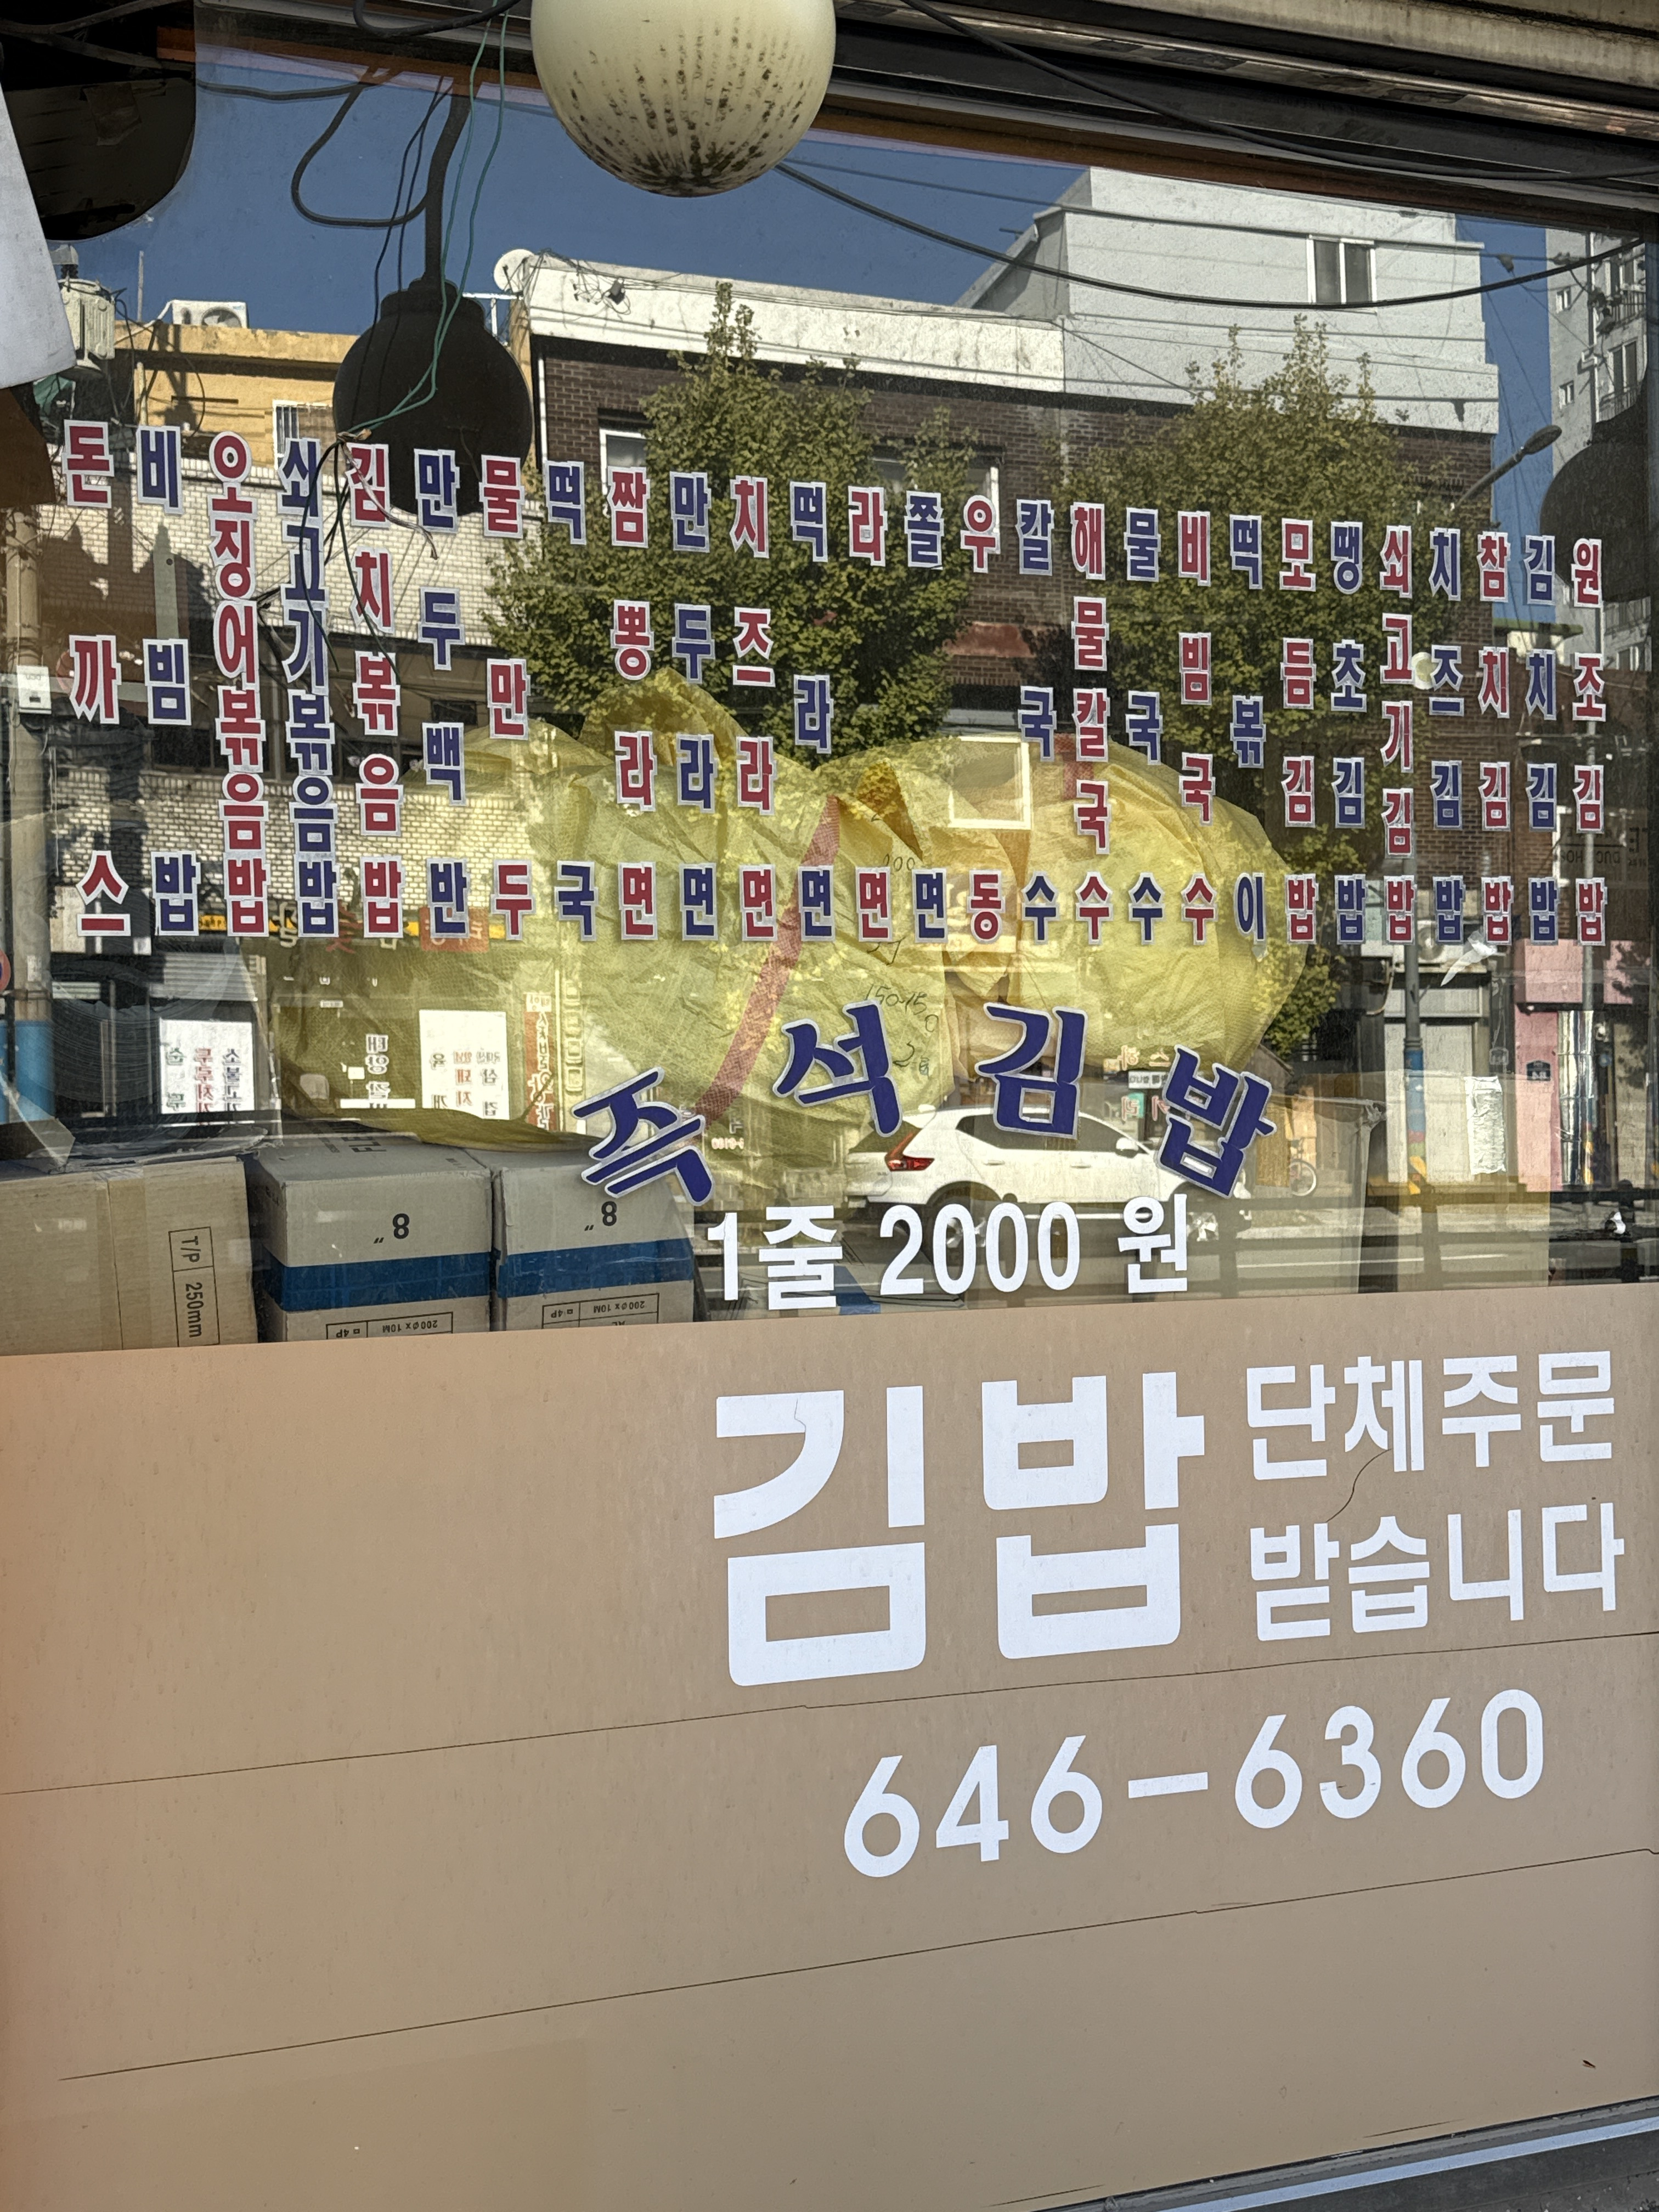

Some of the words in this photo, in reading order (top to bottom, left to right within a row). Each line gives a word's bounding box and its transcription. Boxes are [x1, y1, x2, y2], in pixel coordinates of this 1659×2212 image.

[62, 419, 131, 937] 돈까스
[136, 425, 200, 937] 비빔밥
[209, 431, 269, 938] 오징어볶음밥
[277, 437, 340, 938] 쇠고기볶음밥
[345, 443, 404, 938] 김치볶음밥
[413, 448, 470, 939] 만두백반
[479, 454, 535, 941] 물만두
[546, 461, 598, 941] 떡국
[607, 465, 658, 941] 짬뽕라면
[669, 471, 718, 941] 만두라면
[730, 474, 778, 943] 치즈라면
[789, 481, 836, 943] 떡라면
[848, 486, 892, 943] 라면
[904, 490, 948, 943] 쫄면
[960, 494, 1004, 943] 우동
[1016, 499, 1059, 945] 칼국수
[1070, 501, 1113, 946] 해물칼국수
[1124, 506, 1165, 946] 물국수
[1177, 510, 1217, 946] 비빔국수
[1229, 514, 1266, 943] 떡볶이
[1279, 518, 1318, 944] 모듬김밥
[1330, 521, 1367, 944] 땡초김밥
[1380, 524, 1417, 944] 쇠고기김밥
[1429, 528, 1465, 944] 치즈김밥
[1477, 531, 1514, 945] 참치김밥
[1525, 535, 1559, 945] 김치김밥
[1572, 538, 1607, 945] 원조김밥
[180, 1235, 202, 1263] T/P
[185, 1282, 204, 1338] 250mm
[1246, 1350, 1616, 1481] 단체주문
[713, 1371, 1206, 1687] 김밥
[1249, 1502, 1625, 1642] 받습니다
[843, 1689, 1544, 1878] 646-6360
